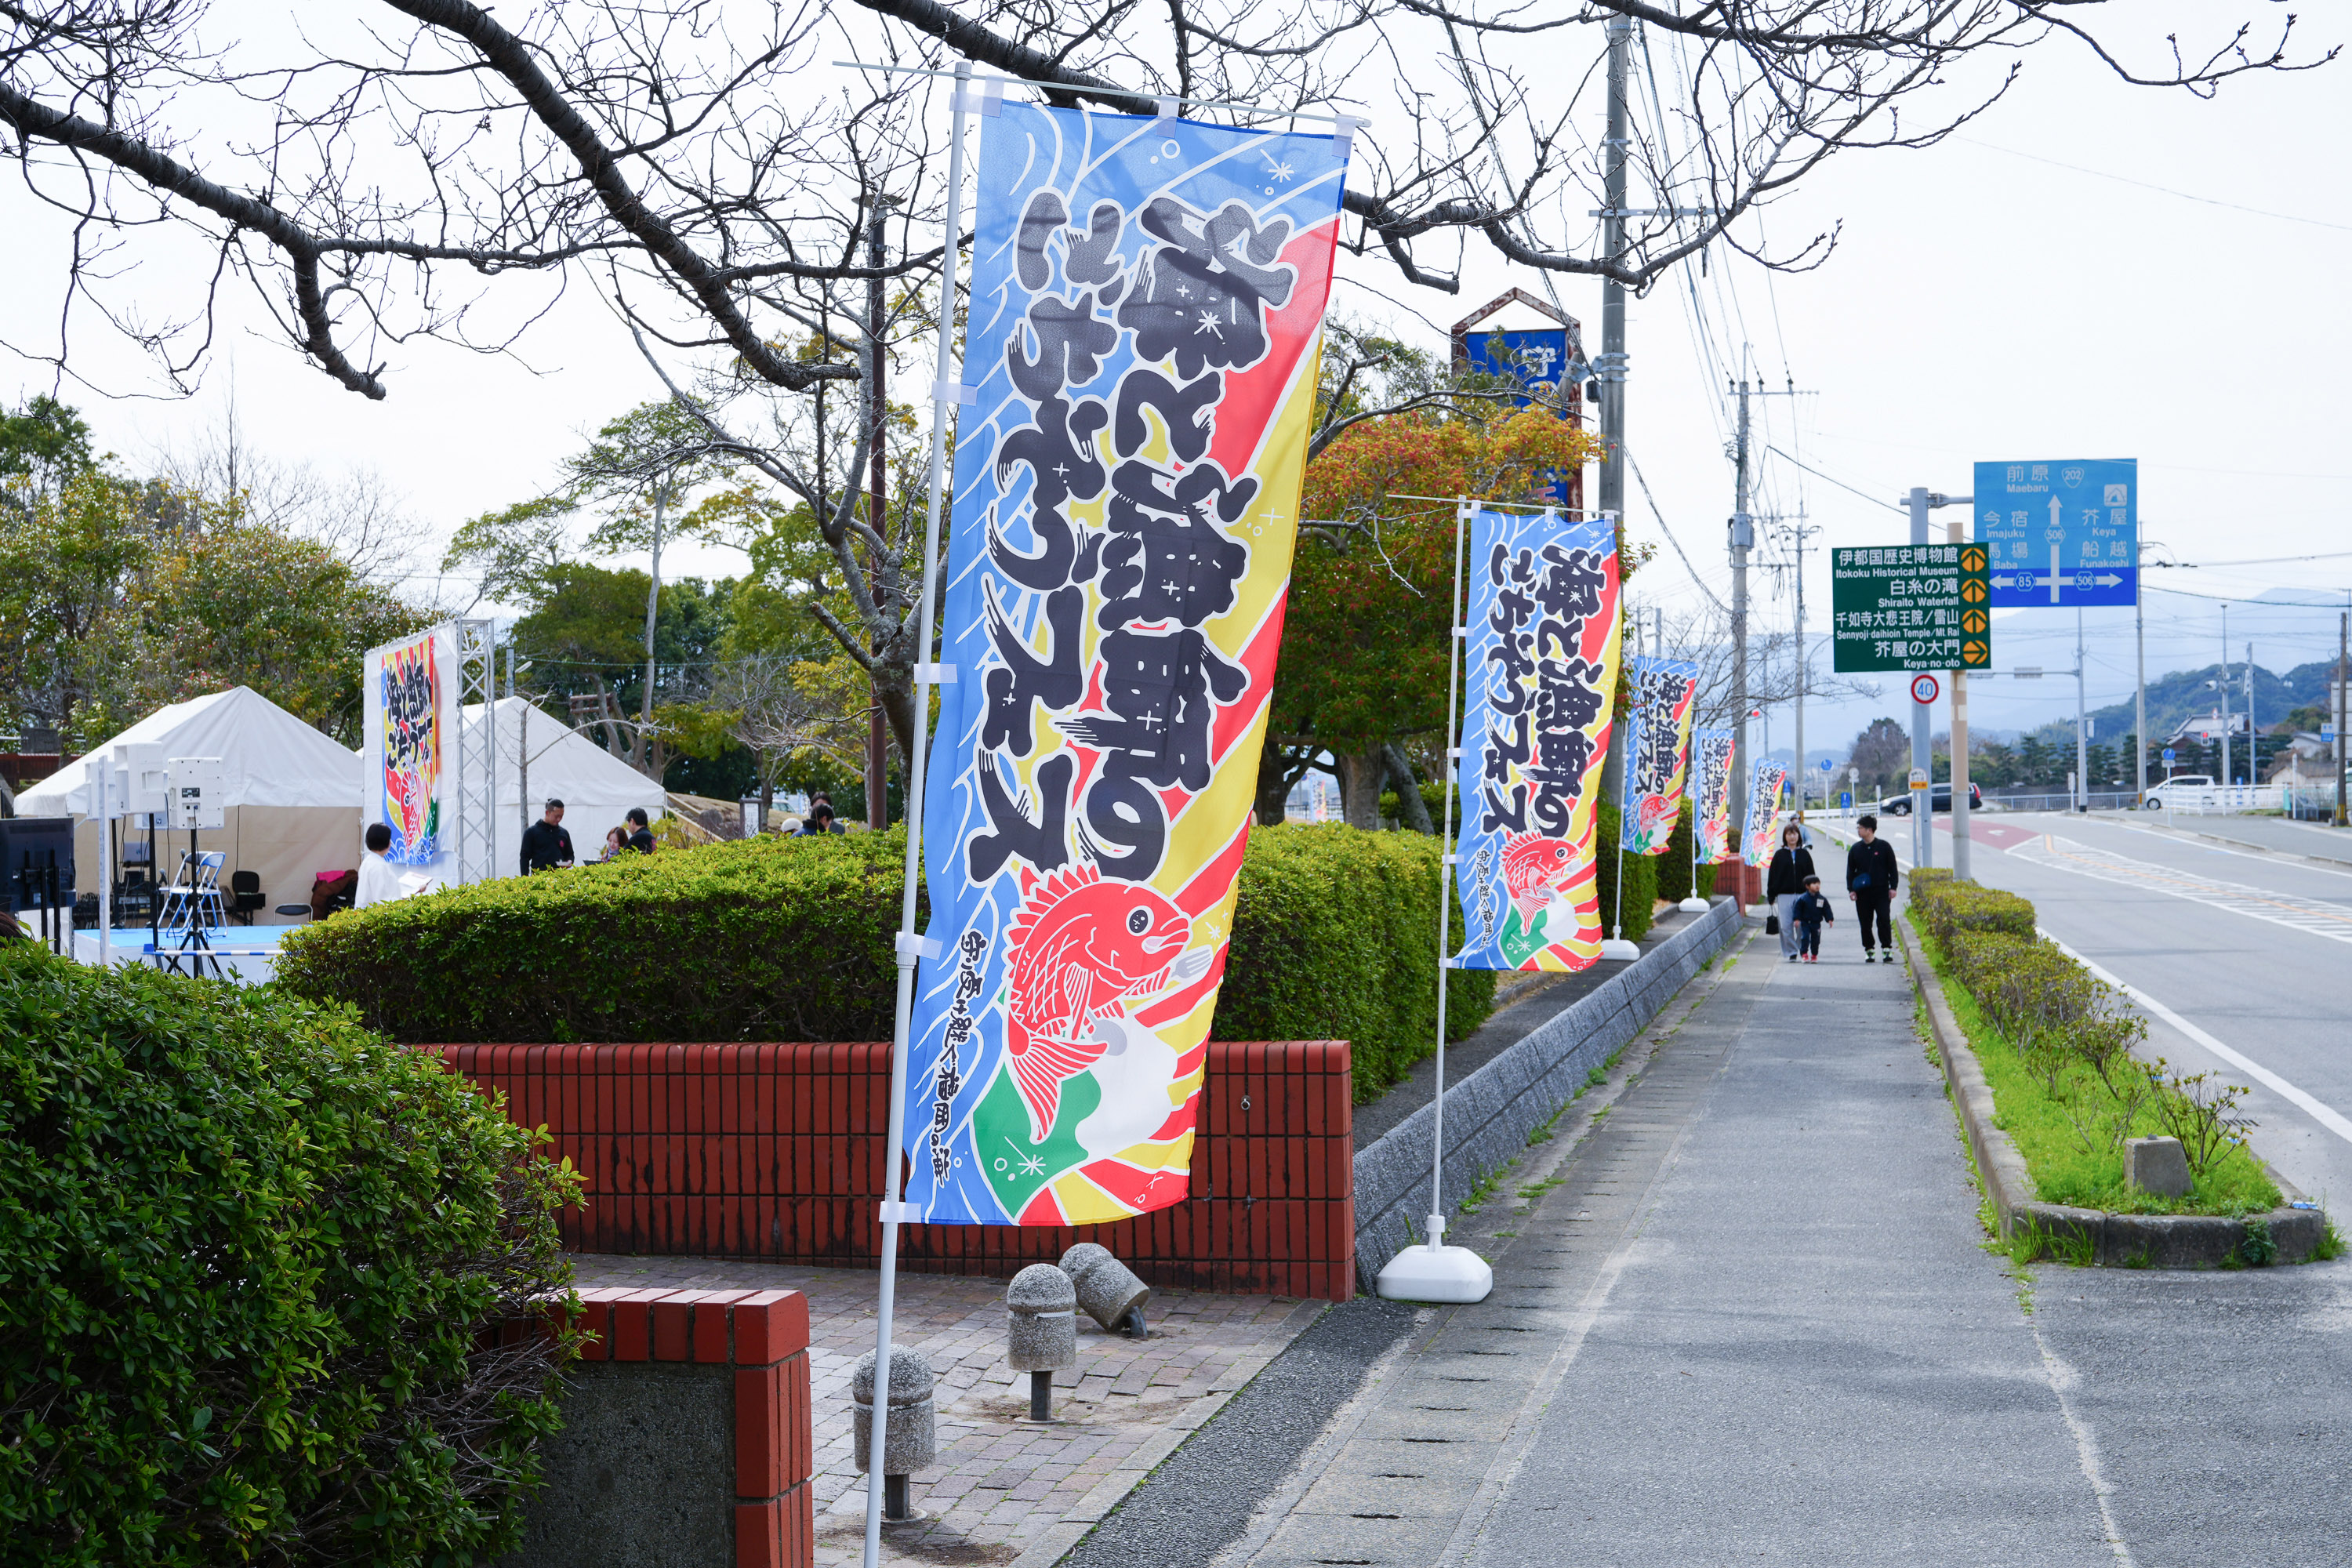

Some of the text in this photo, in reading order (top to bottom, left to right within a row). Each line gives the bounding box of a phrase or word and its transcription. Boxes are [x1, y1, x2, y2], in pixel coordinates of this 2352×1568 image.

[2007, 464, 2049, 482] 前原
[2065, 470, 2081, 480] 202
[2007, 484, 2049, 492] Maebaru
[1984, 510, 2028, 528] 今宿
[2082, 509, 2127, 526] 芥屋
[970, 192, 1124, 881] ごちそうフェス
[1054, 197, 1296, 880] 海と漁師の
[1987, 528, 2025, 539] Imajuku
[2047, 530, 2063, 539] 506
[2092, 527, 2116, 538] Keya
[1838, 546, 1958, 566] 伊都国歴史博物館
[1988, 542, 2028, 559] 馬場
[2082, 540, 2127, 557] 船越
[1994, 561, 2018, 569] Baba
[2080, 558, 2129, 568] Funakoshi
[1836, 566, 1958, 579] Itokoku Historical Museum
[2078, 575, 2092, 586] 506
[1890, 578, 1958, 596] 白糸の滝
[2018, 576, 2031, 587] 85
[1878, 596, 1958, 608] Shiraito Waterfall
[1947, 627, 1960, 637] Rai
[1875, 639, 1960, 658] 芥屋の大門
[1904, 658, 1960, 670] Keya-no-oto
[1483, 544, 1537, 833] ごちそうフェス
[1526, 544, 1606, 837] 海と漁師の
[1917, 683, 1933, 696] 40
[1635, 671, 1658, 793] ごちそうフェス
[1653, 672, 1688, 795] 海と漁師の
[932, 931, 987, 1185] 守り受け継ぐ福岡の海
